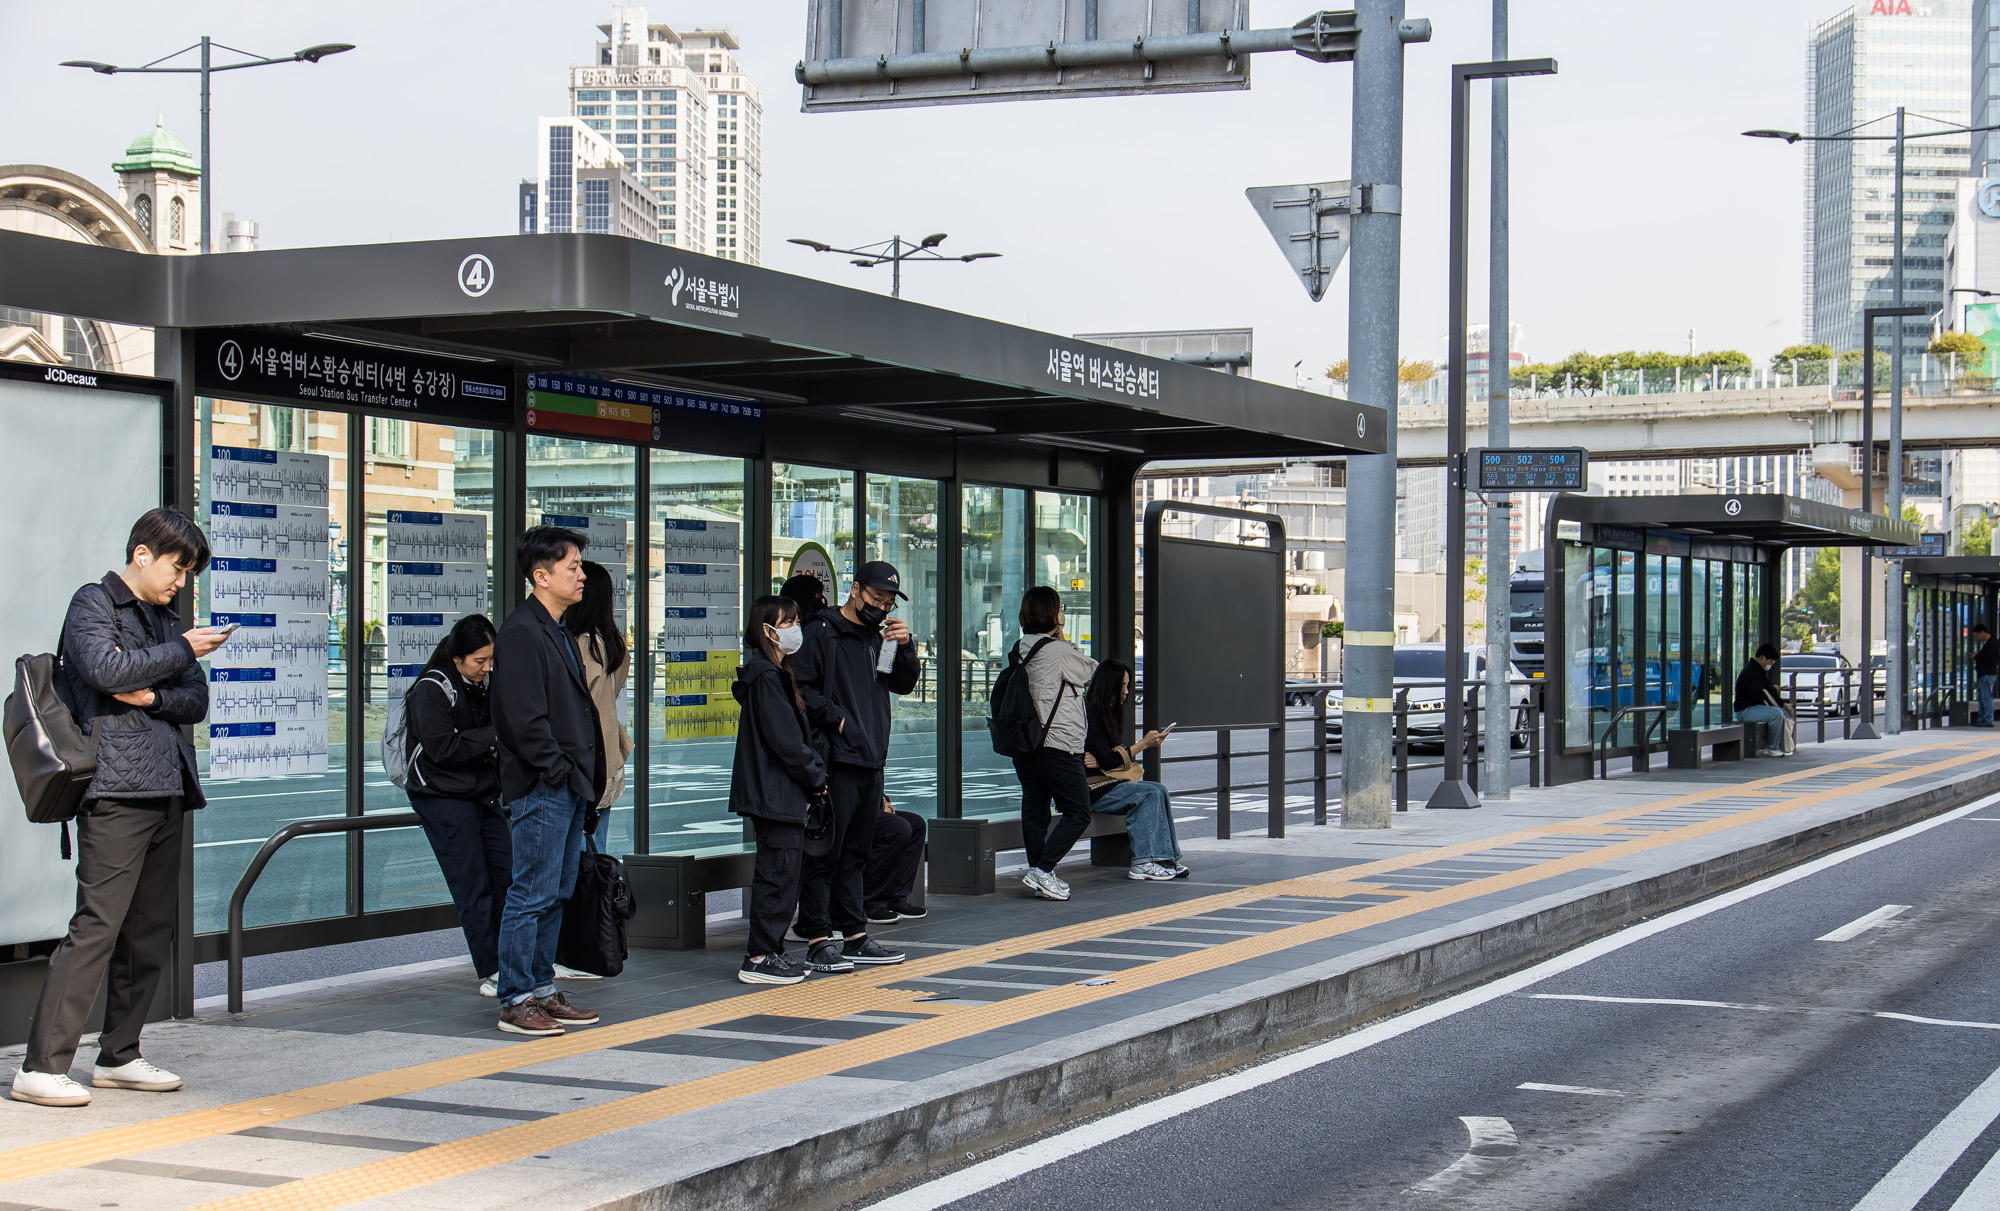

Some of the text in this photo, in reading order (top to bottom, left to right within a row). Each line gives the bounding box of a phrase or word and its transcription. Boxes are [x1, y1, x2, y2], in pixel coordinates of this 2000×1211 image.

[1870, 0, 1912, 15] AIA
[583, 69, 670, 85] Brown Stone
[685, 276, 739, 309] 서울특별시
[45, 368, 97, 387] JCDecaux
[250, 346, 406, 392] 서울역버스환승센터(4번
[412, 368, 456, 399] 승강장)
[1046, 348, 1159, 400] 서울역 버스환승센터
[299, 384, 418, 408] Seoul Station Bus Transfer Center 4
[538, 378, 548, 388] 100
[551, 380, 561, 390] 150
[564, 382, 573, 392] 151
[576, 383, 586, 394] 152
[589, 385, 599, 396] 162
[602, 387, 611, 397] 202
[614, 388, 623, 399] 421
[627, 390, 637, 400] 500
[640, 392, 649, 402] 501
[652, 394, 661, 404] 502
[664, 396, 672, 405] 503
[675, 397, 684, 406] 504
[687, 399, 695, 408] 505
[699, 400, 707, 409] 506
[753, 408, 761, 418] 752
[608, 406, 631, 418] N15 N75
[217, 449, 231, 462] 100
[1485, 454, 1565, 464] 500 502 504
[217, 505, 230, 517] 150
[391, 513, 403, 525] 421
[668, 521, 677, 532] 752
[217, 561, 229, 573] 151
[391, 565, 404, 577] 500
[668, 565, 680, 576] 750A
[668, 609, 680, 620] 750B
[216, 616, 229, 627] 152
[391, 616, 403, 628] 501
[671, 651, 681, 662] N15
[216, 671, 229, 684] 162
[392, 668, 403, 680] 502
[671, 695, 681, 706] N75
[216, 727, 229, 739] 202
